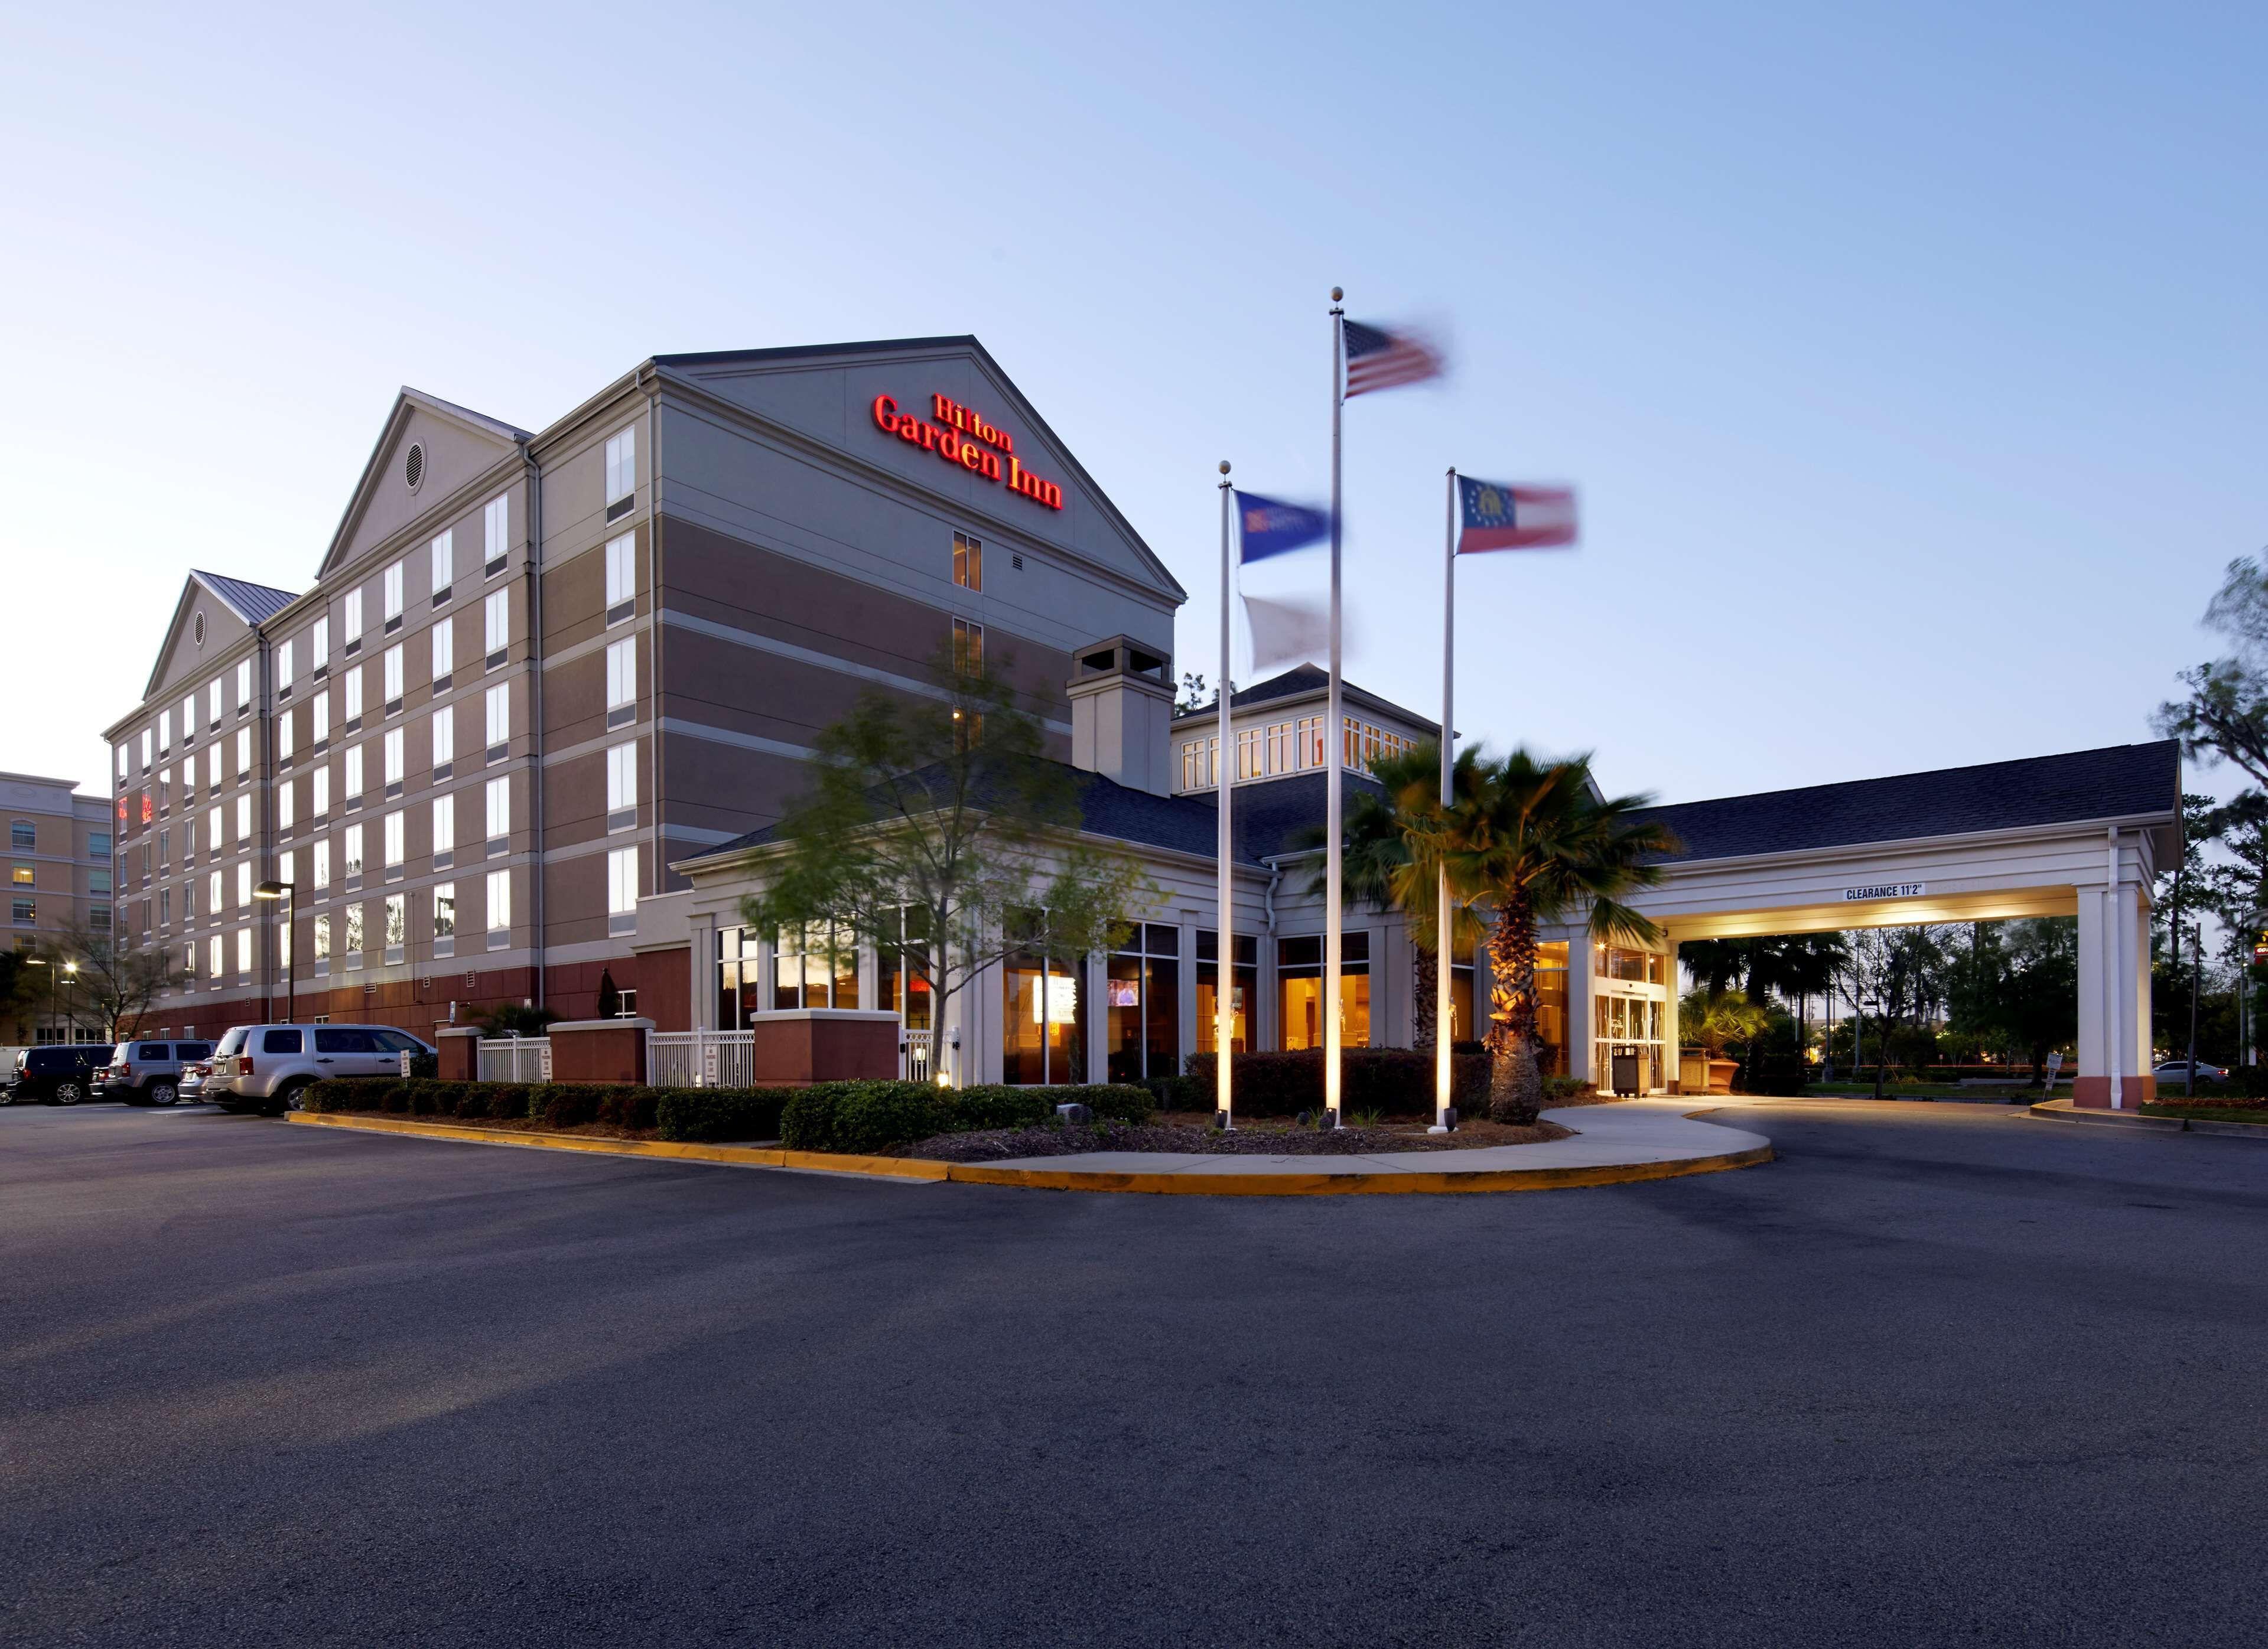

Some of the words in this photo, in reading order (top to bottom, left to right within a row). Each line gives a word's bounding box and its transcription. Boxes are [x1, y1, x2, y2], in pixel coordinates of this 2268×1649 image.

[871, 394, 1002, 481] Garden
[1006, 455, 1063, 510] Inn
[931, 393, 1013, 454] Hilton
[1847, 886, 1898, 900] CLEARANCE
[1901, 884, 1922, 895] 11'2"
